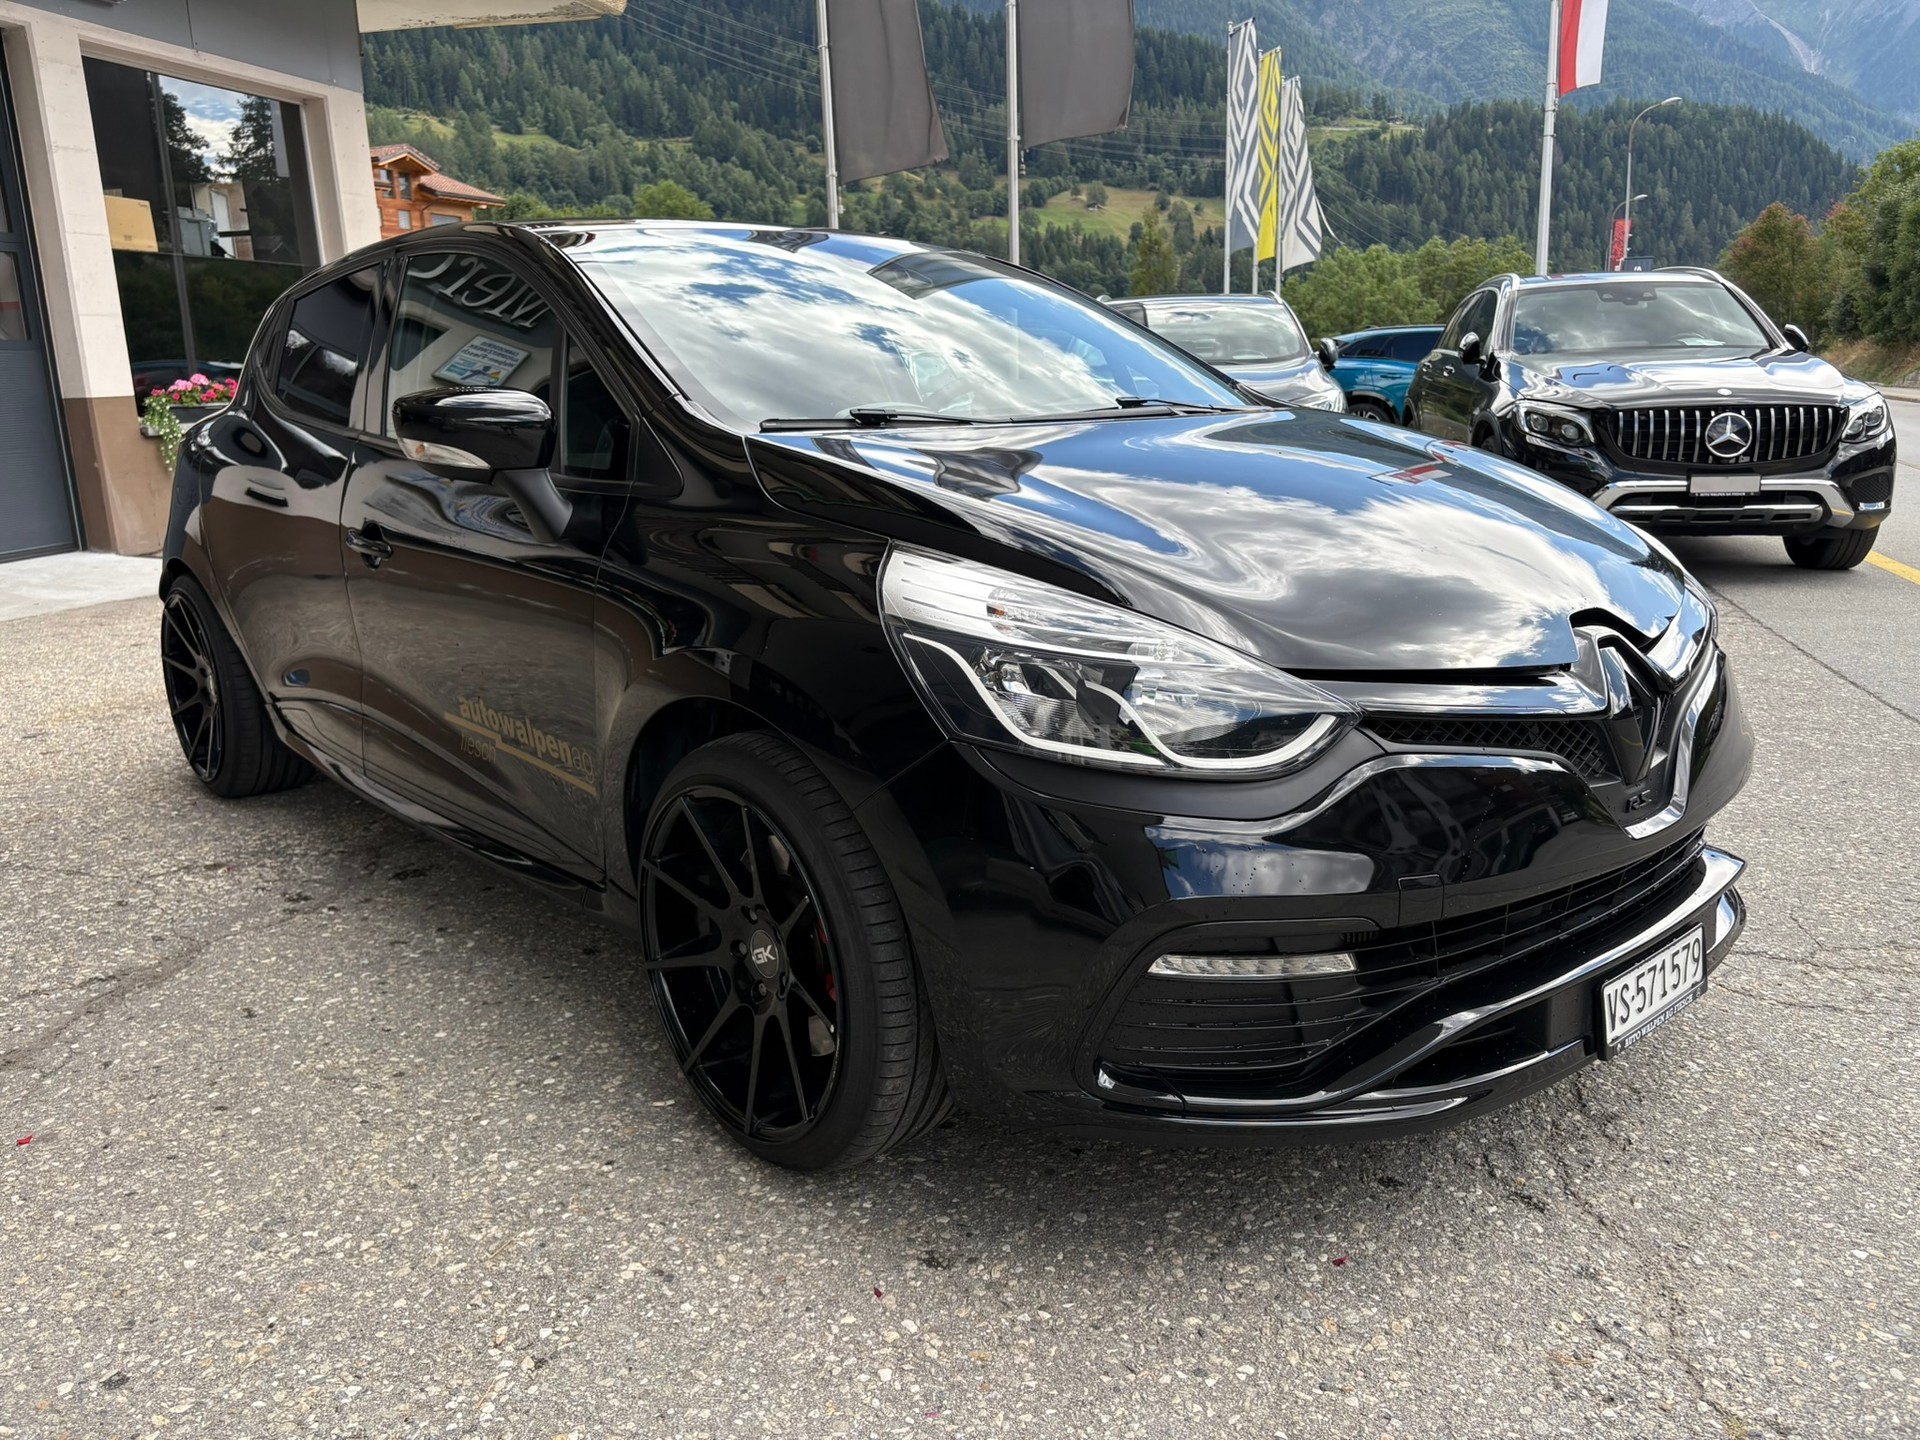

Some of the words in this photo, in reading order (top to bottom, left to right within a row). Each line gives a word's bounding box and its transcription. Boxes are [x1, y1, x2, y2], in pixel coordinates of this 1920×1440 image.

[1626, 789, 1653, 812] RS
[1624, 1031, 1641, 1048] AUTO
[1665, 1007, 1674, 1020] AG
